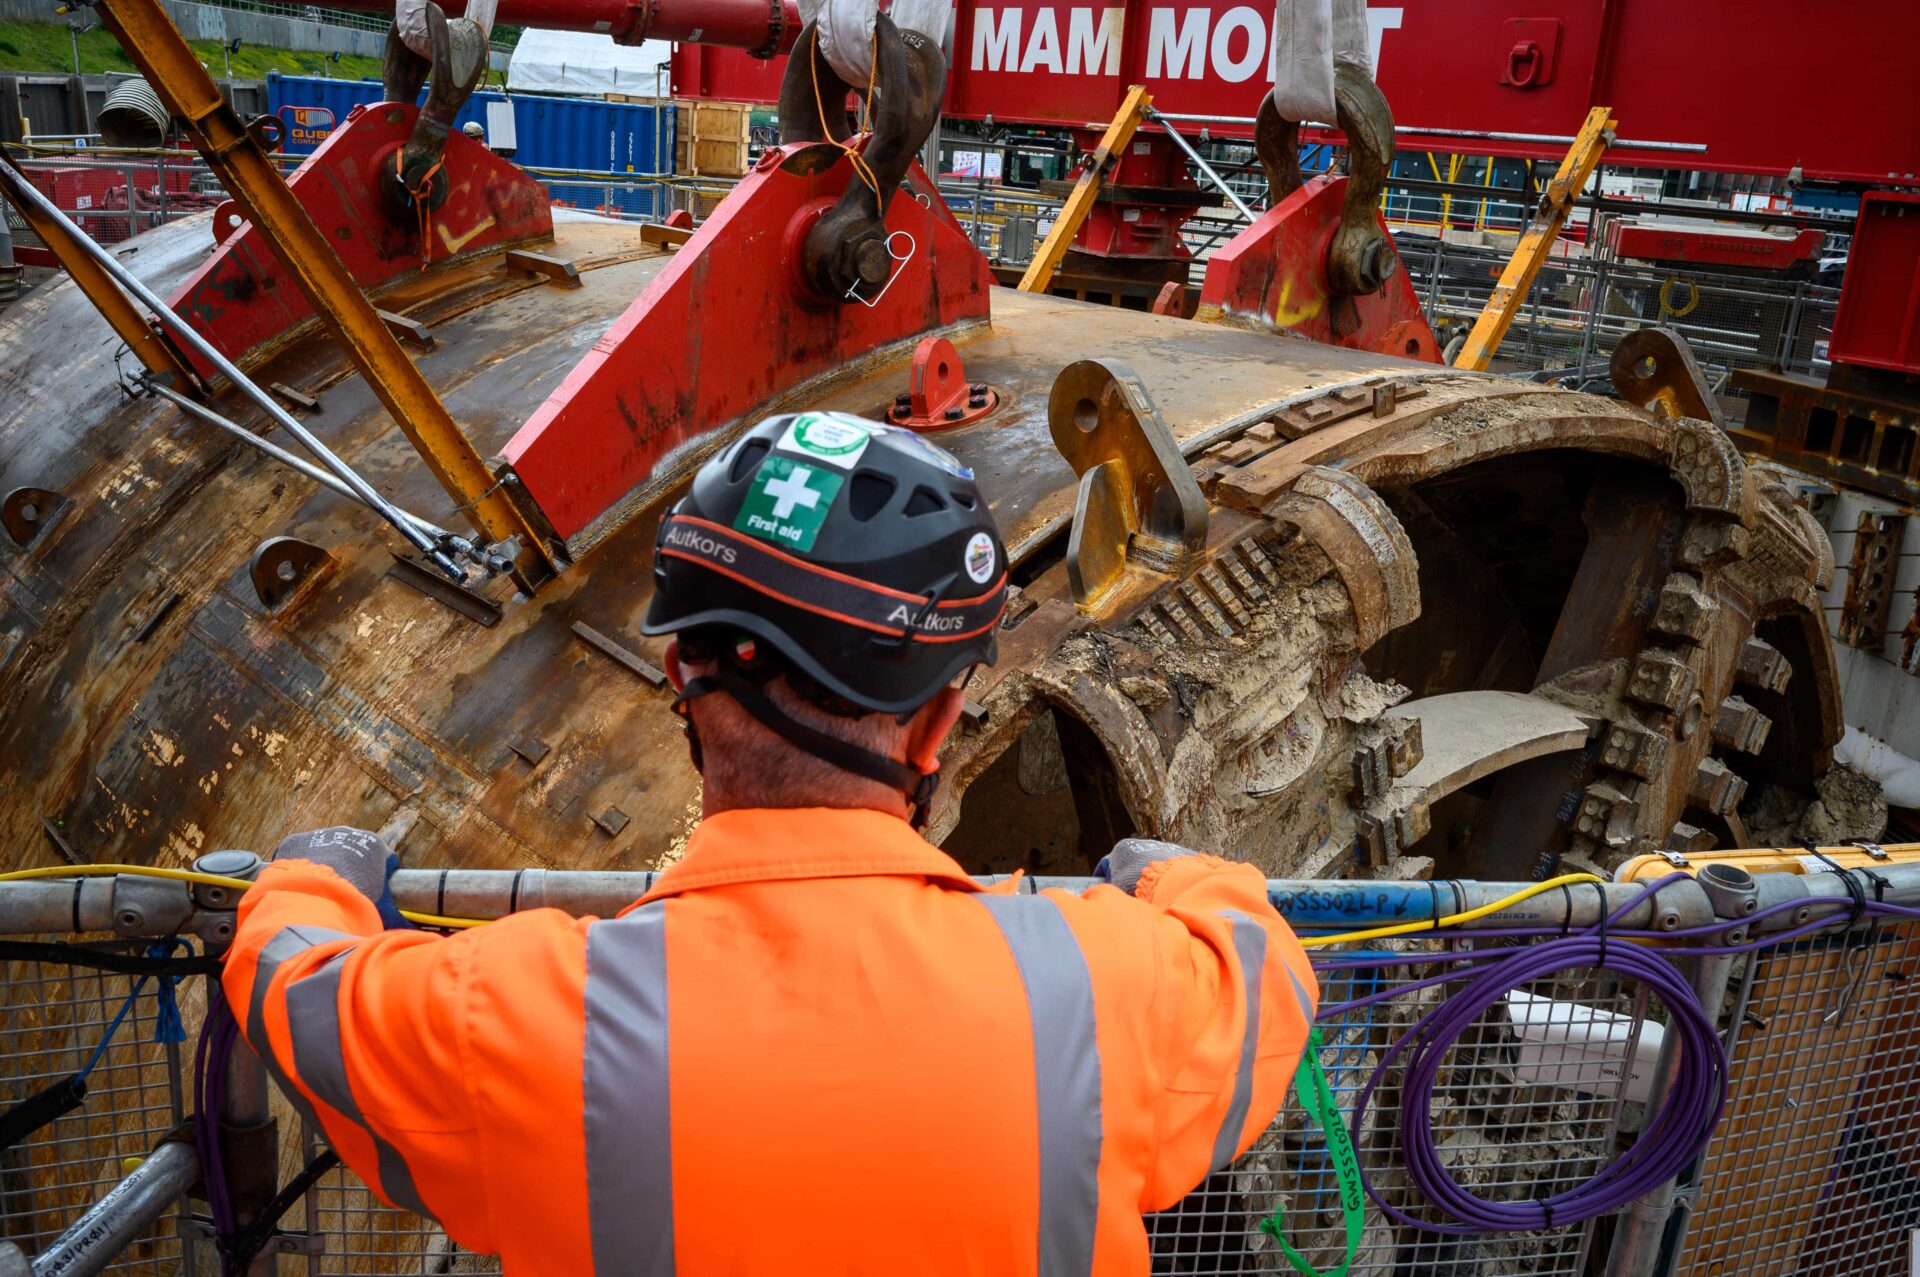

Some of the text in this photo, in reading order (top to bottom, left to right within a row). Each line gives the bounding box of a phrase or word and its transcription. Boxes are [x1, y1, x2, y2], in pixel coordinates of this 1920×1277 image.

[665, 526, 738, 565] Autkors
[747, 514, 803, 542] First aid
[1328, 1107, 1361, 1211] GWSSS02LP
